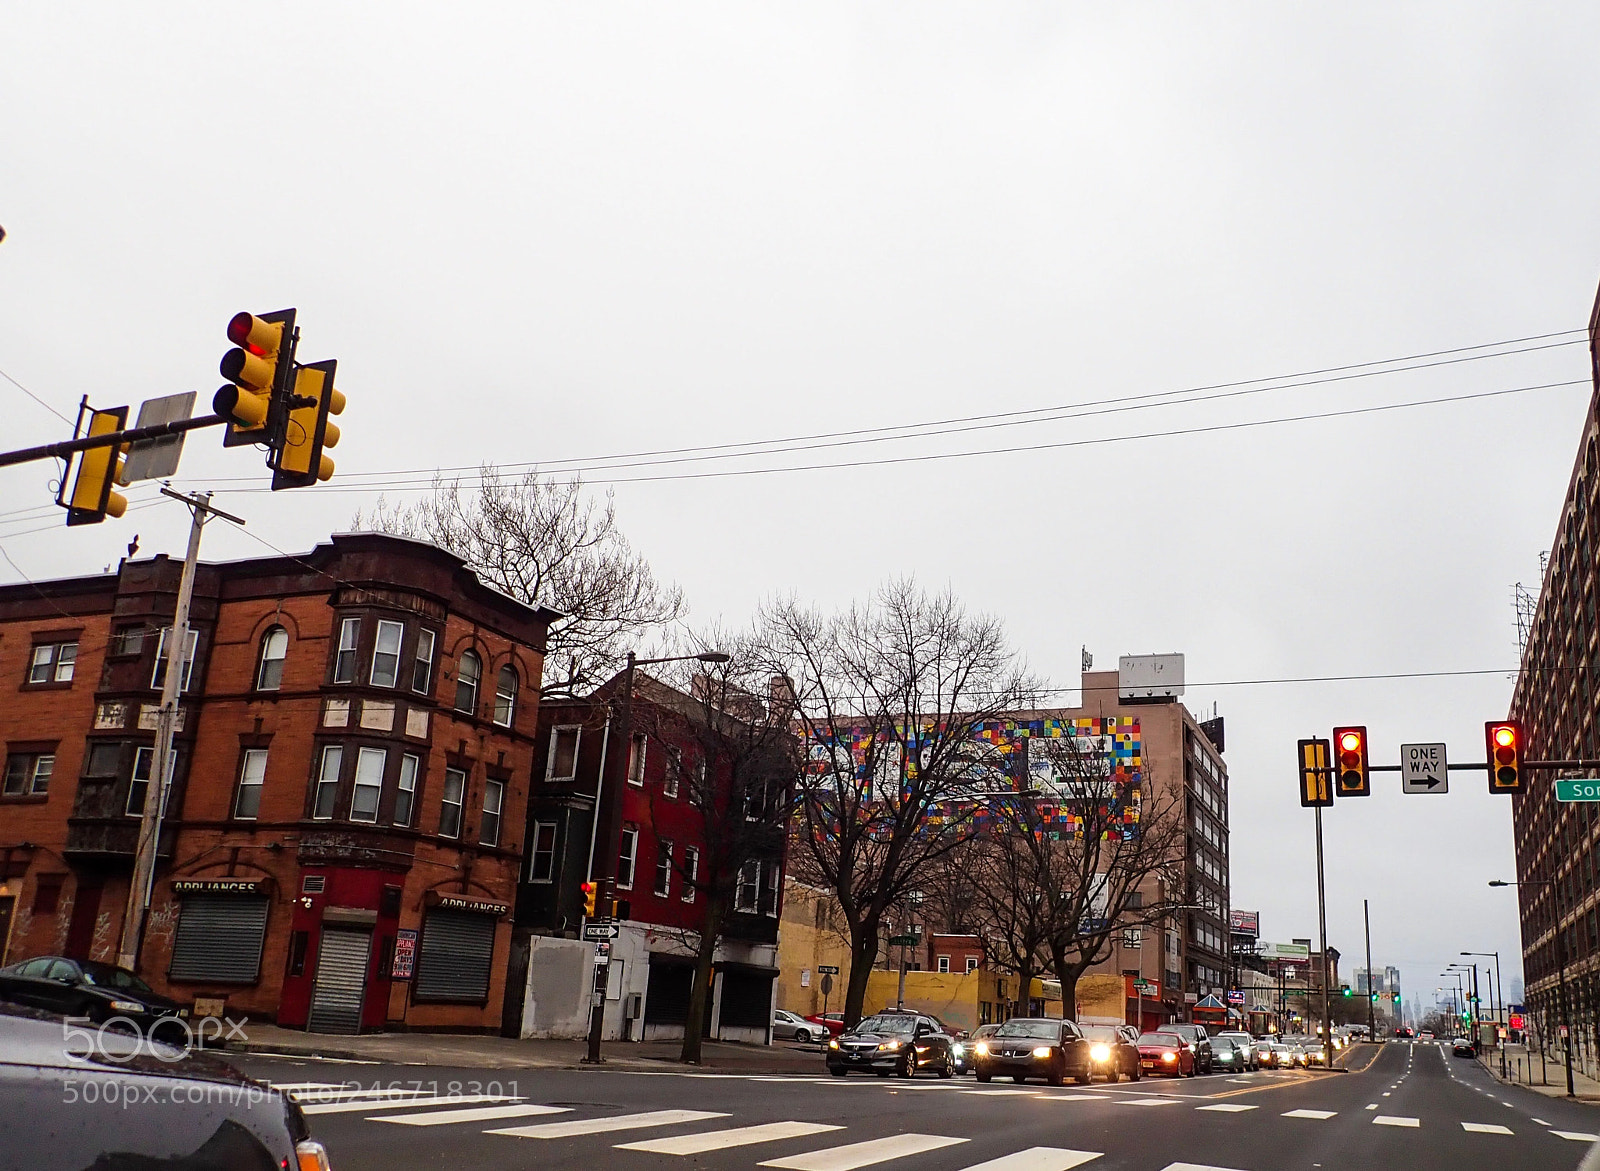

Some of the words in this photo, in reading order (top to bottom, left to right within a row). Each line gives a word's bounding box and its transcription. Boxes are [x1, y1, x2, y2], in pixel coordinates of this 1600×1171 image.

[1410, 748, 1438, 759] ONE
[1410, 761, 1439, 773] WAY
[1573, 784, 1600, 797] So
[175, 882, 256, 893] APPLIANCES
[398, 949, 411, 957] OPEN
